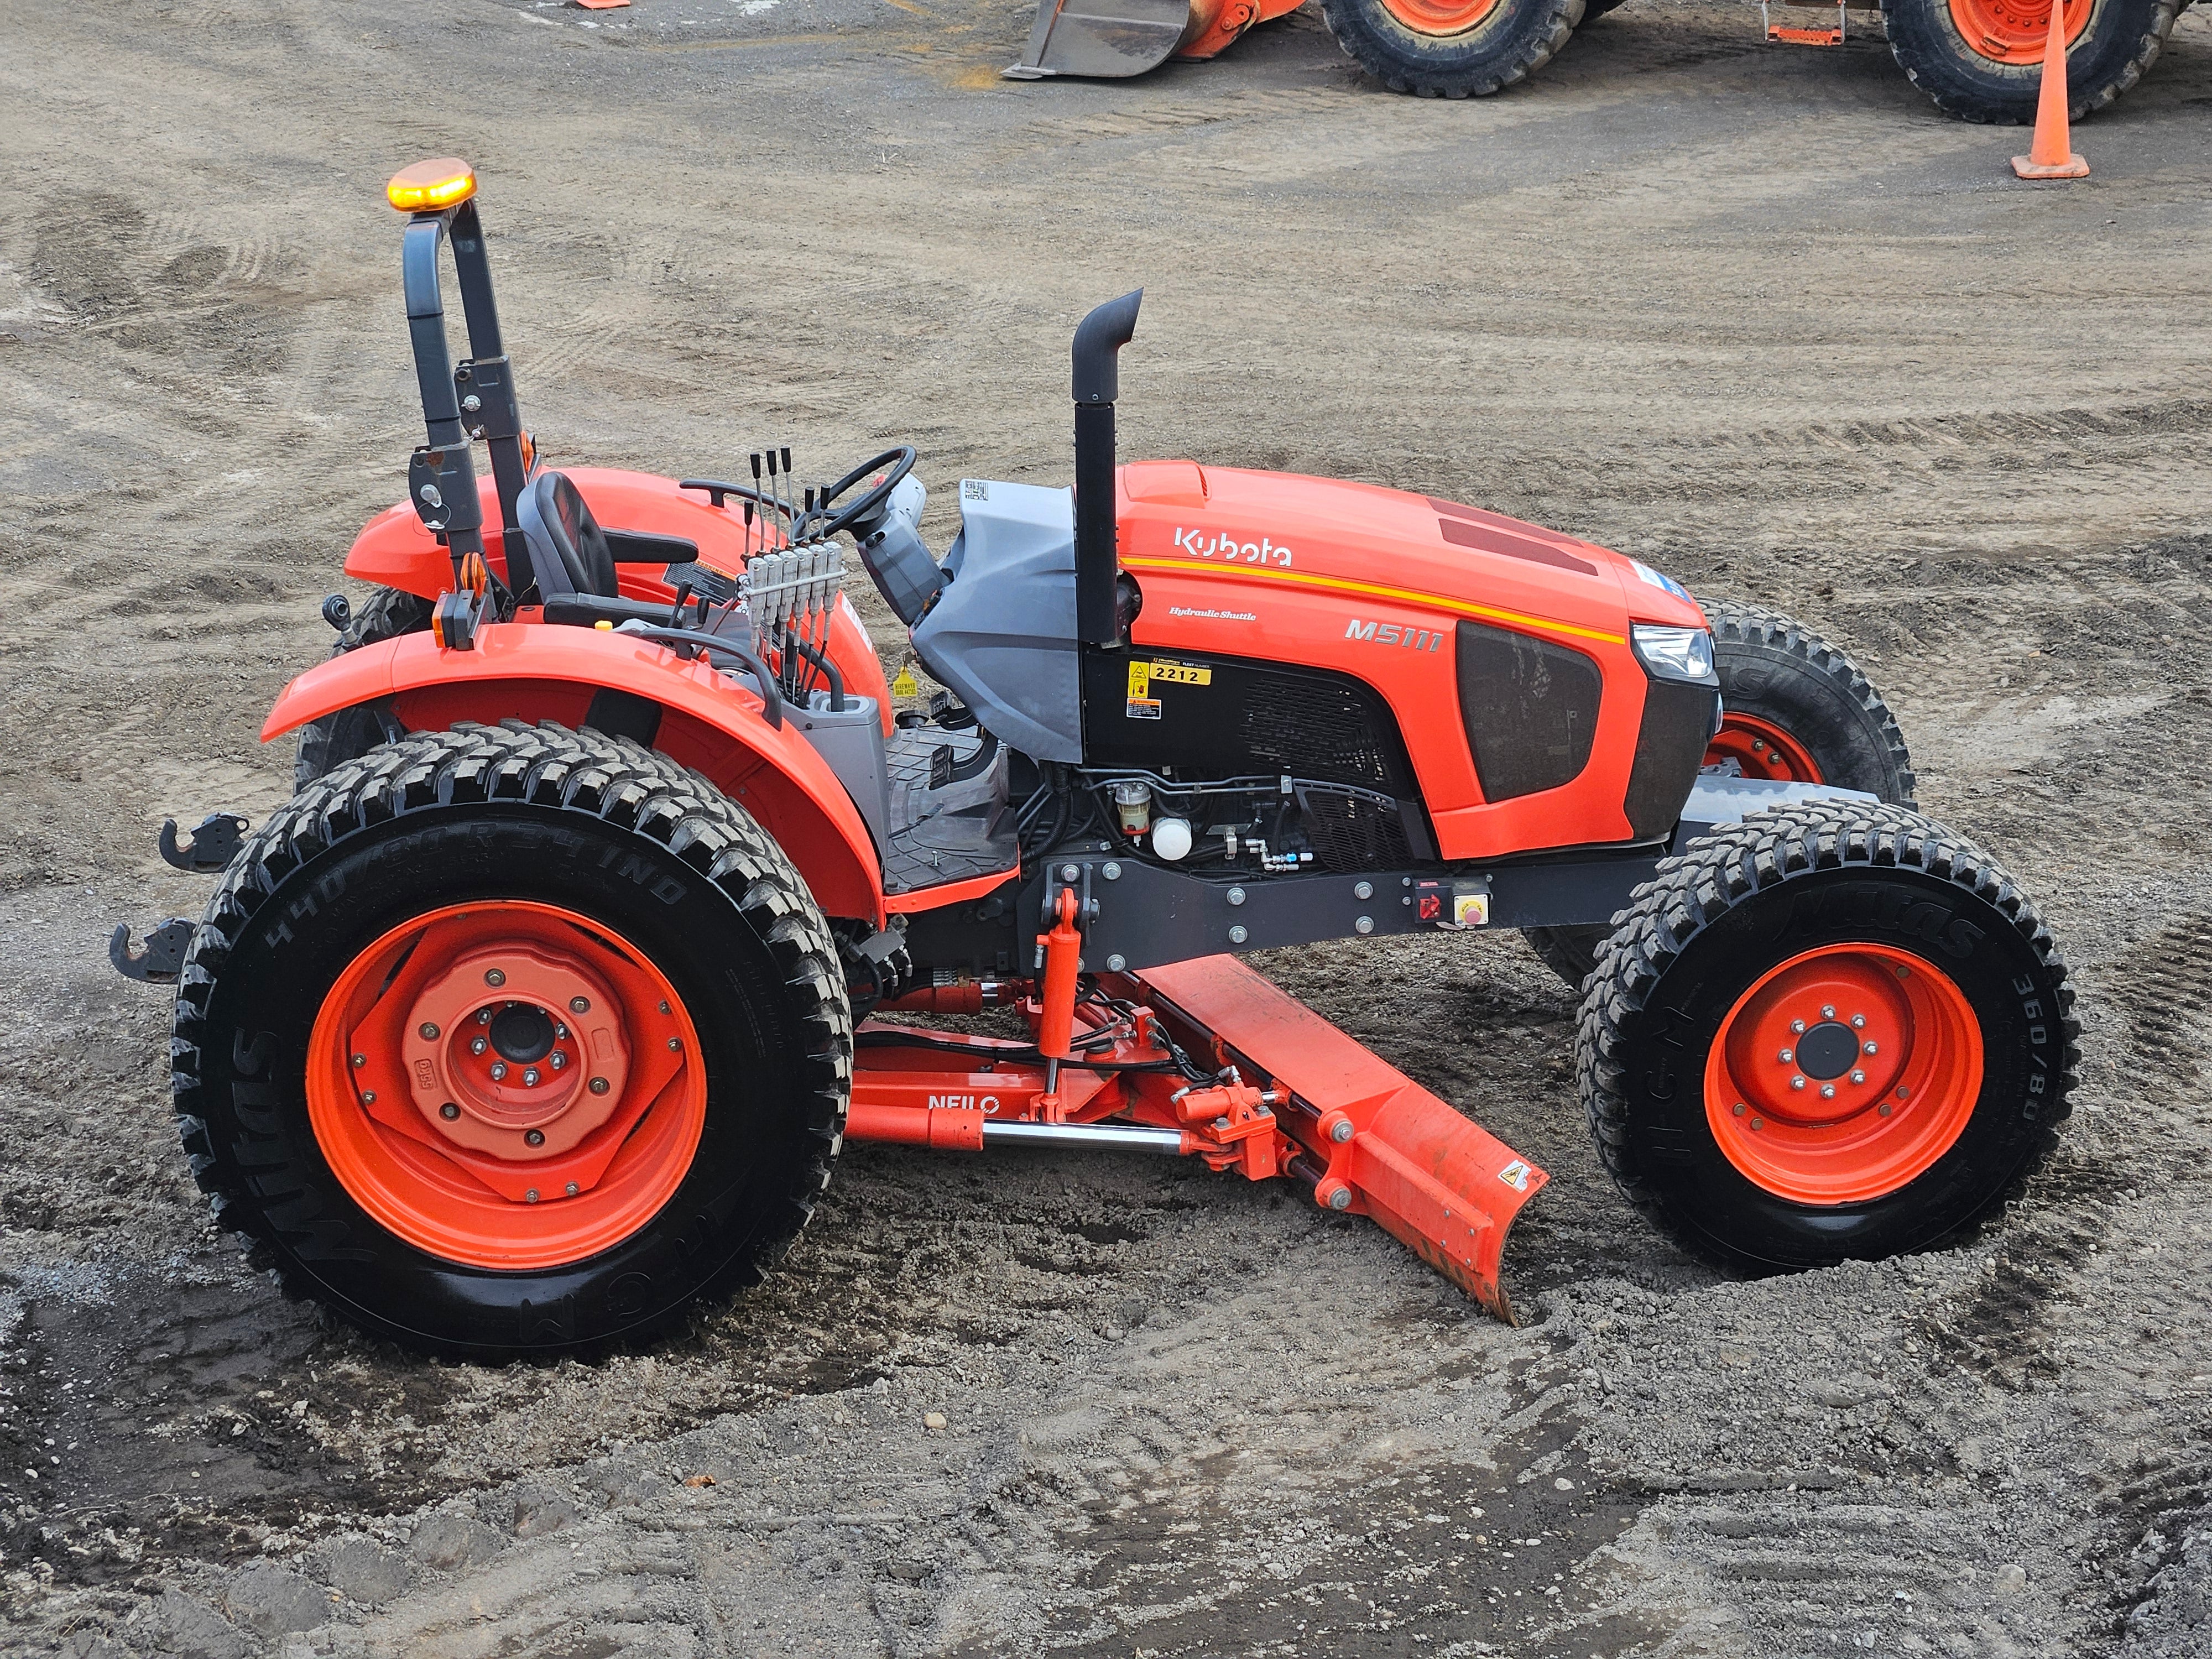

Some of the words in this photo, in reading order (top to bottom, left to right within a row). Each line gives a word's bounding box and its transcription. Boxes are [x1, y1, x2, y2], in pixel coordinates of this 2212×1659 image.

[1174, 527, 1292, 567] Kubota
[697, 560, 723, 575] WARNING
[1169, 607, 1219, 617] Hydraulic
[1219, 611, 1256, 621] Shuttle
[1345, 619, 1443, 653] M5111
[1156, 667, 1198, 682] 2212
[264, 826, 446, 949] 440/80
[467, 823, 497, 848] R
[597, 846, 688, 906] IND
[2011, 972, 2048, 1123] 360/80
